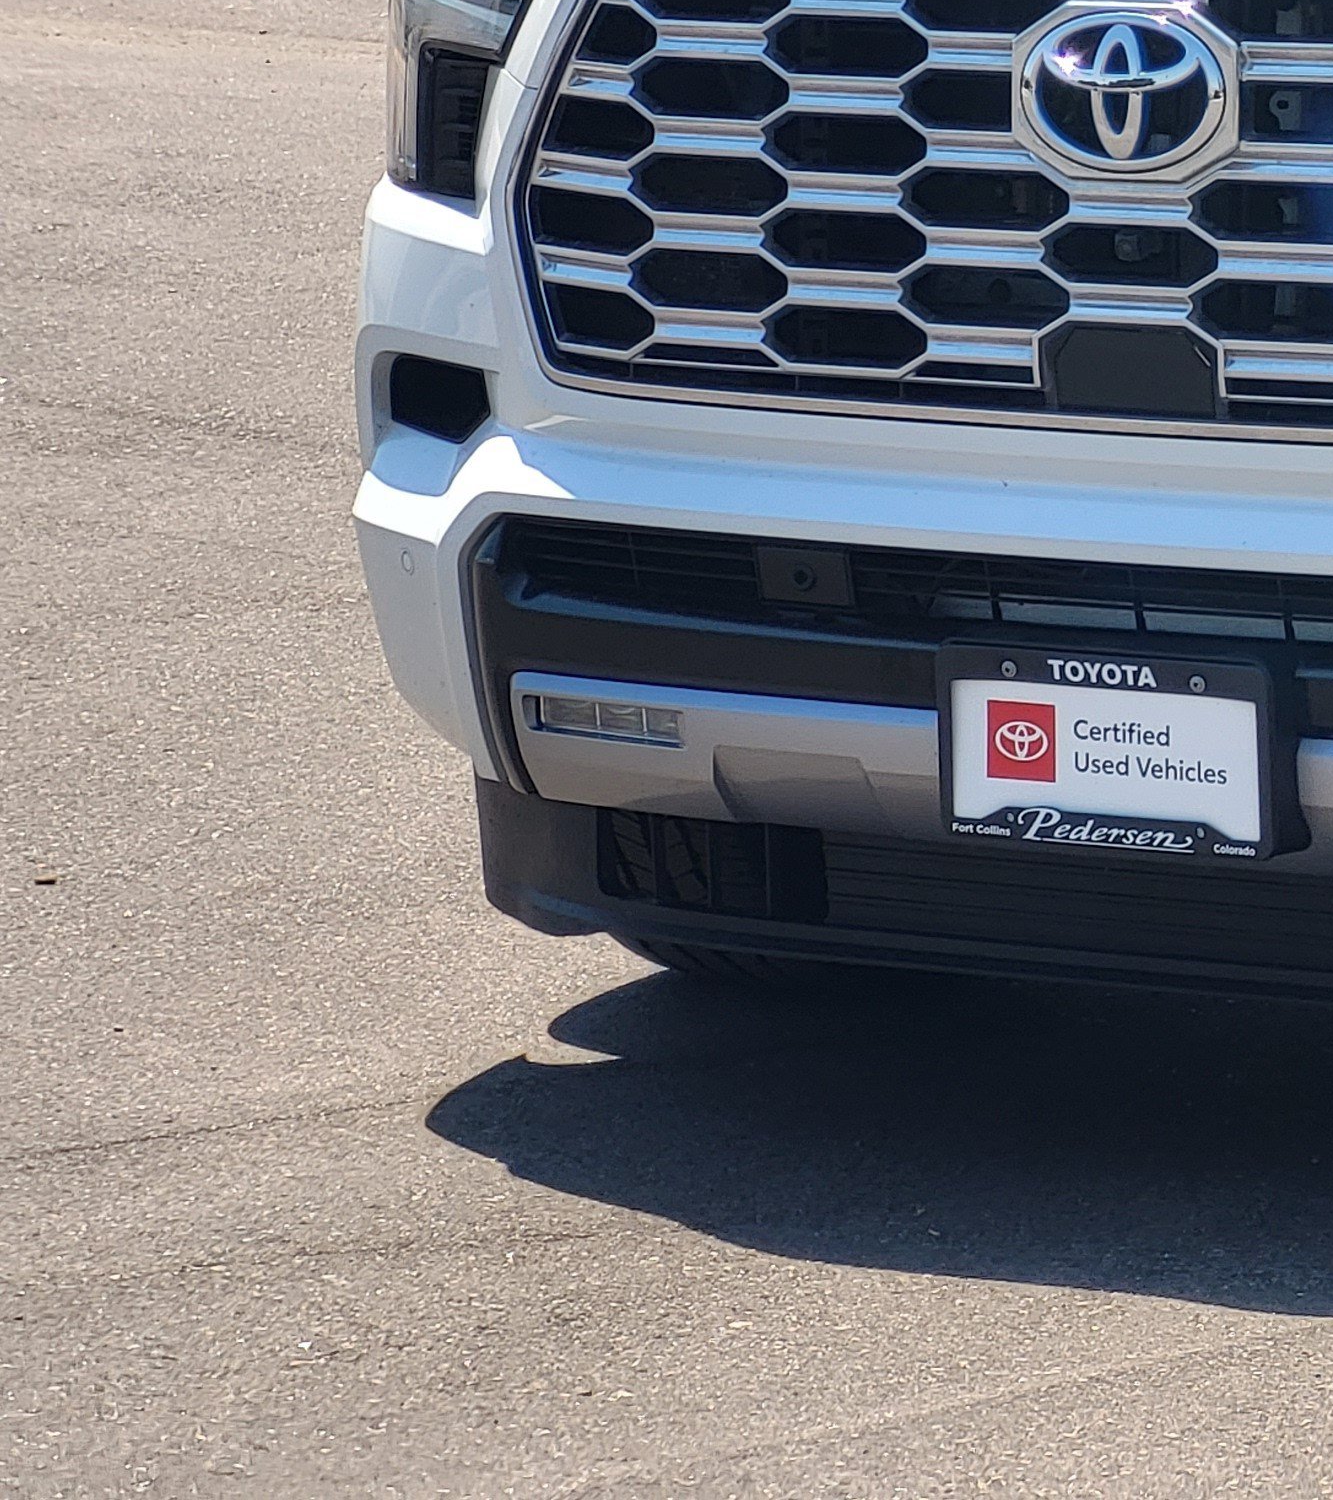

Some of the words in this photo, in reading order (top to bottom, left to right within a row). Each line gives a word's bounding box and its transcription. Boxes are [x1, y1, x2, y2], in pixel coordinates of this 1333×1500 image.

[1047, 658, 1157, 688] TOYOTA
[1073, 718, 1171, 747] Certified
[1073, 750, 1130, 777] Used
[1136, 756, 1228, 785] Vehicles
[952, 821, 975, 835] Fort
[976, 823, 1011, 837] Collins
[1017, 807, 1194, 850] Pedersen
[1213, 842, 1257, 858] Colorado
